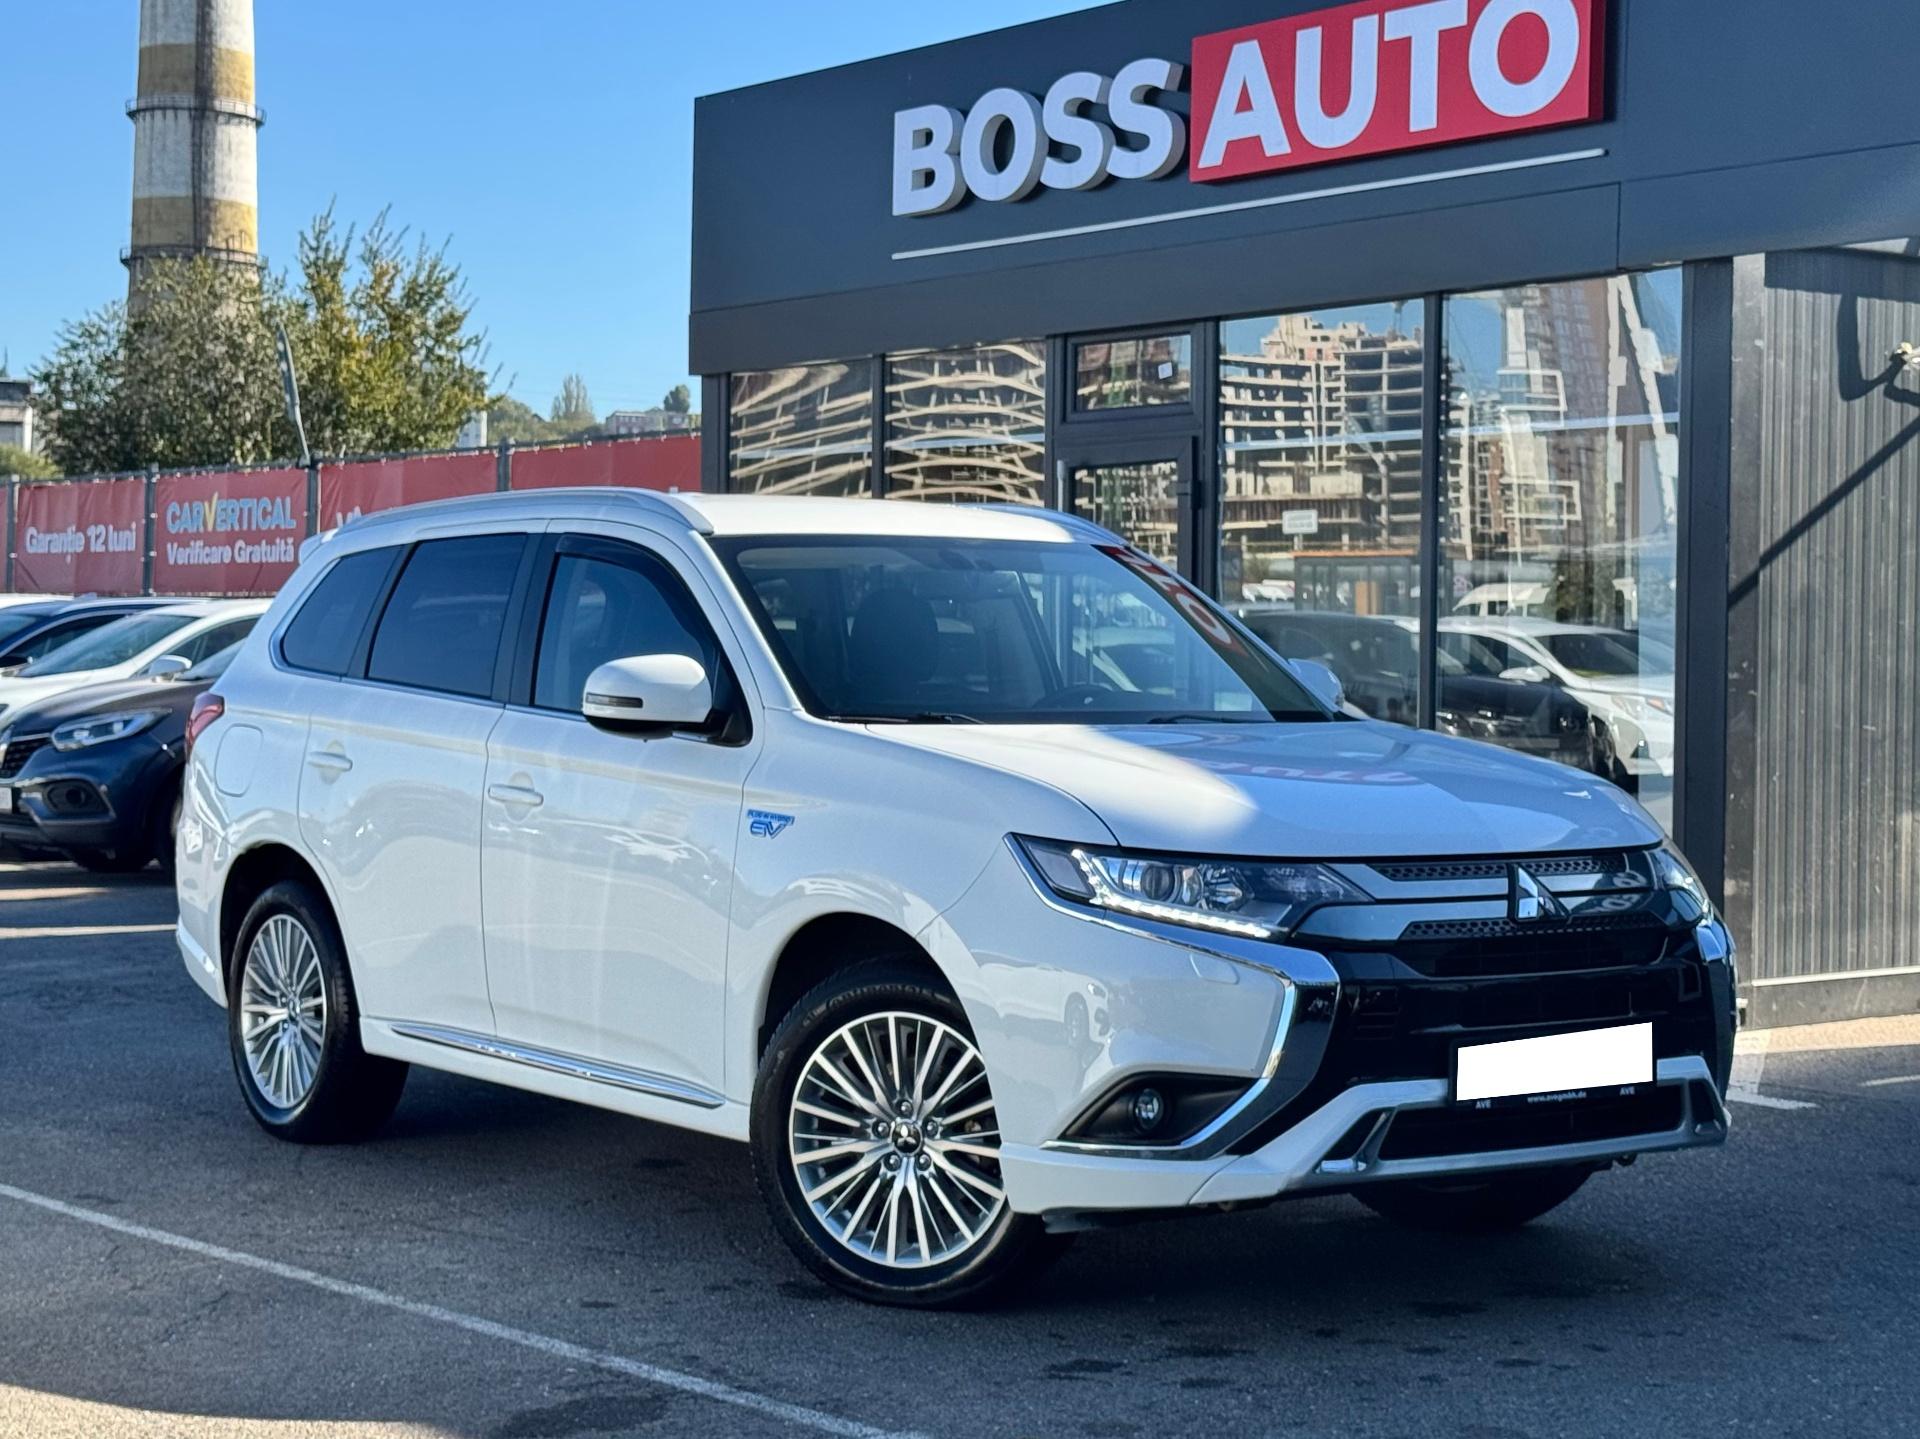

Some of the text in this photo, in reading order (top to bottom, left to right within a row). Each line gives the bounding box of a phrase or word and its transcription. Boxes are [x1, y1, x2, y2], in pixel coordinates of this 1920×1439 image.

[892, 0, 1580, 216] BOSS AUTO
[166, 491, 297, 534] CARVERTICAL
[86, 524, 106, 553] 12
[107, 521, 137, 552] luni
[166, 536, 295, 565] Verificare Gratuită
